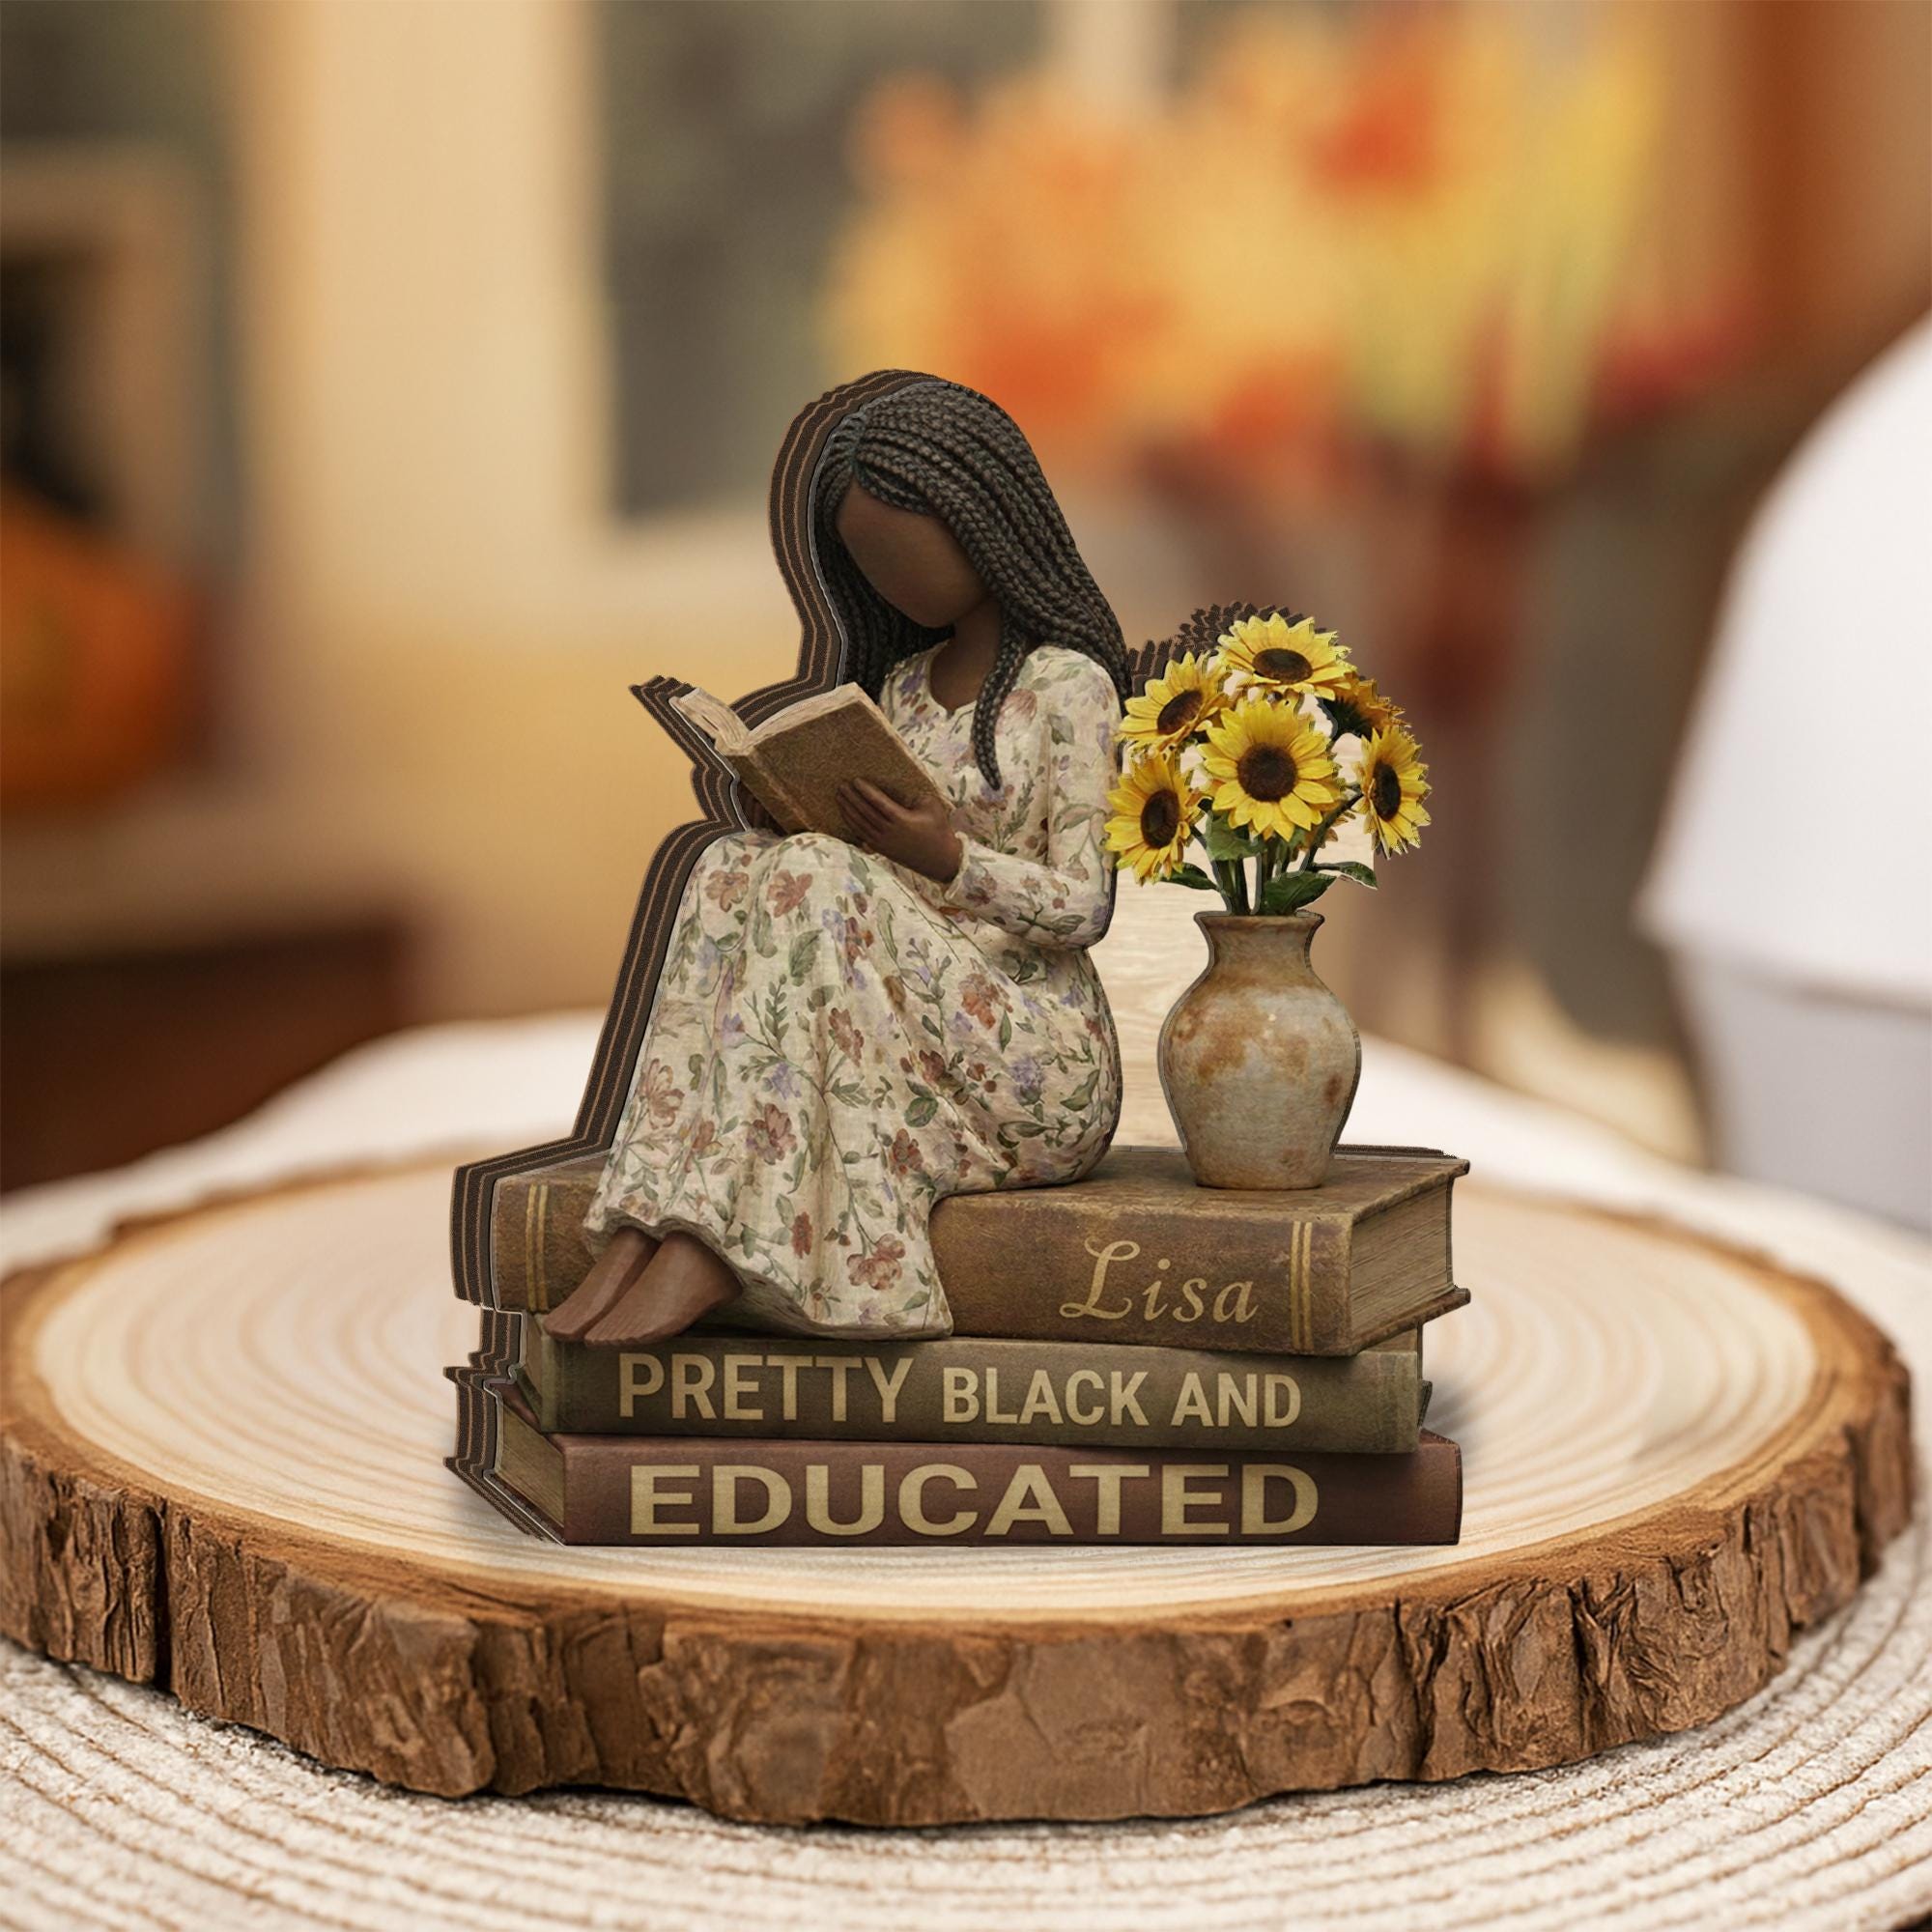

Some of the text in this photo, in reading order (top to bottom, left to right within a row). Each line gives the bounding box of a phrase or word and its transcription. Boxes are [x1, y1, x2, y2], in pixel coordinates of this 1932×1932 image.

[1059, 1236, 1260, 1323] Lisa
[618, 1351, 1302, 1429] PRETTY BLACK AND
[630, 1463, 1320, 1537] EDUCATED
